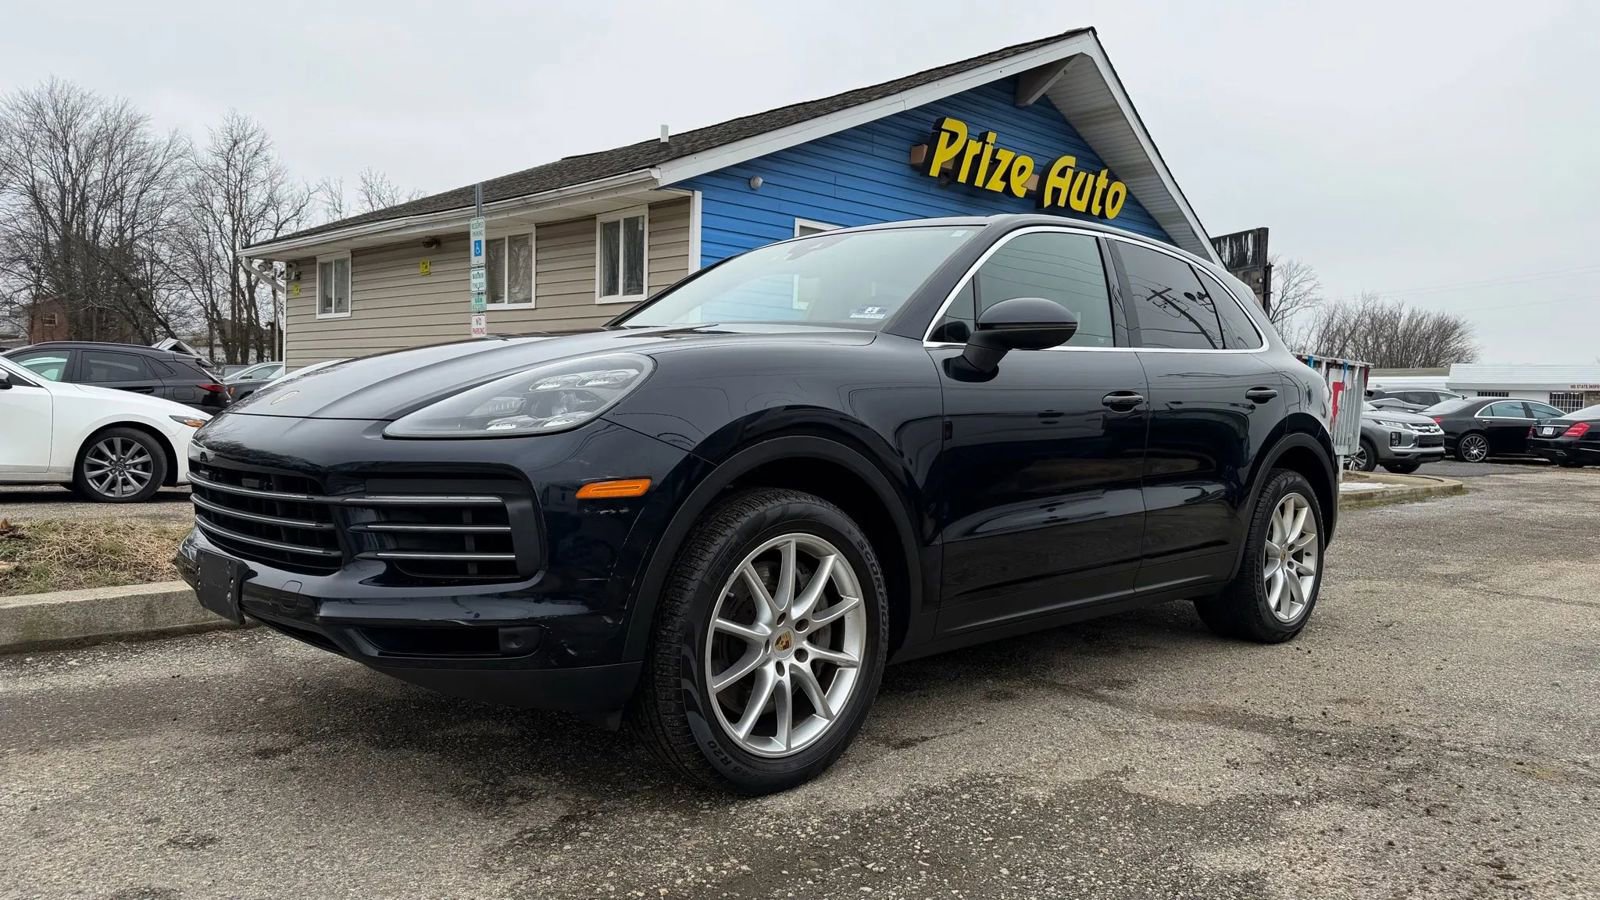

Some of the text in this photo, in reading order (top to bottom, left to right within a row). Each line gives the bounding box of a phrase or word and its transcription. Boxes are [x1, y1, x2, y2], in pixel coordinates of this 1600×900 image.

[929, 117, 1128, 220] Prize Auto
[856, 539, 888, 644] SCORPION
[707, 740, 733, 767] R20
